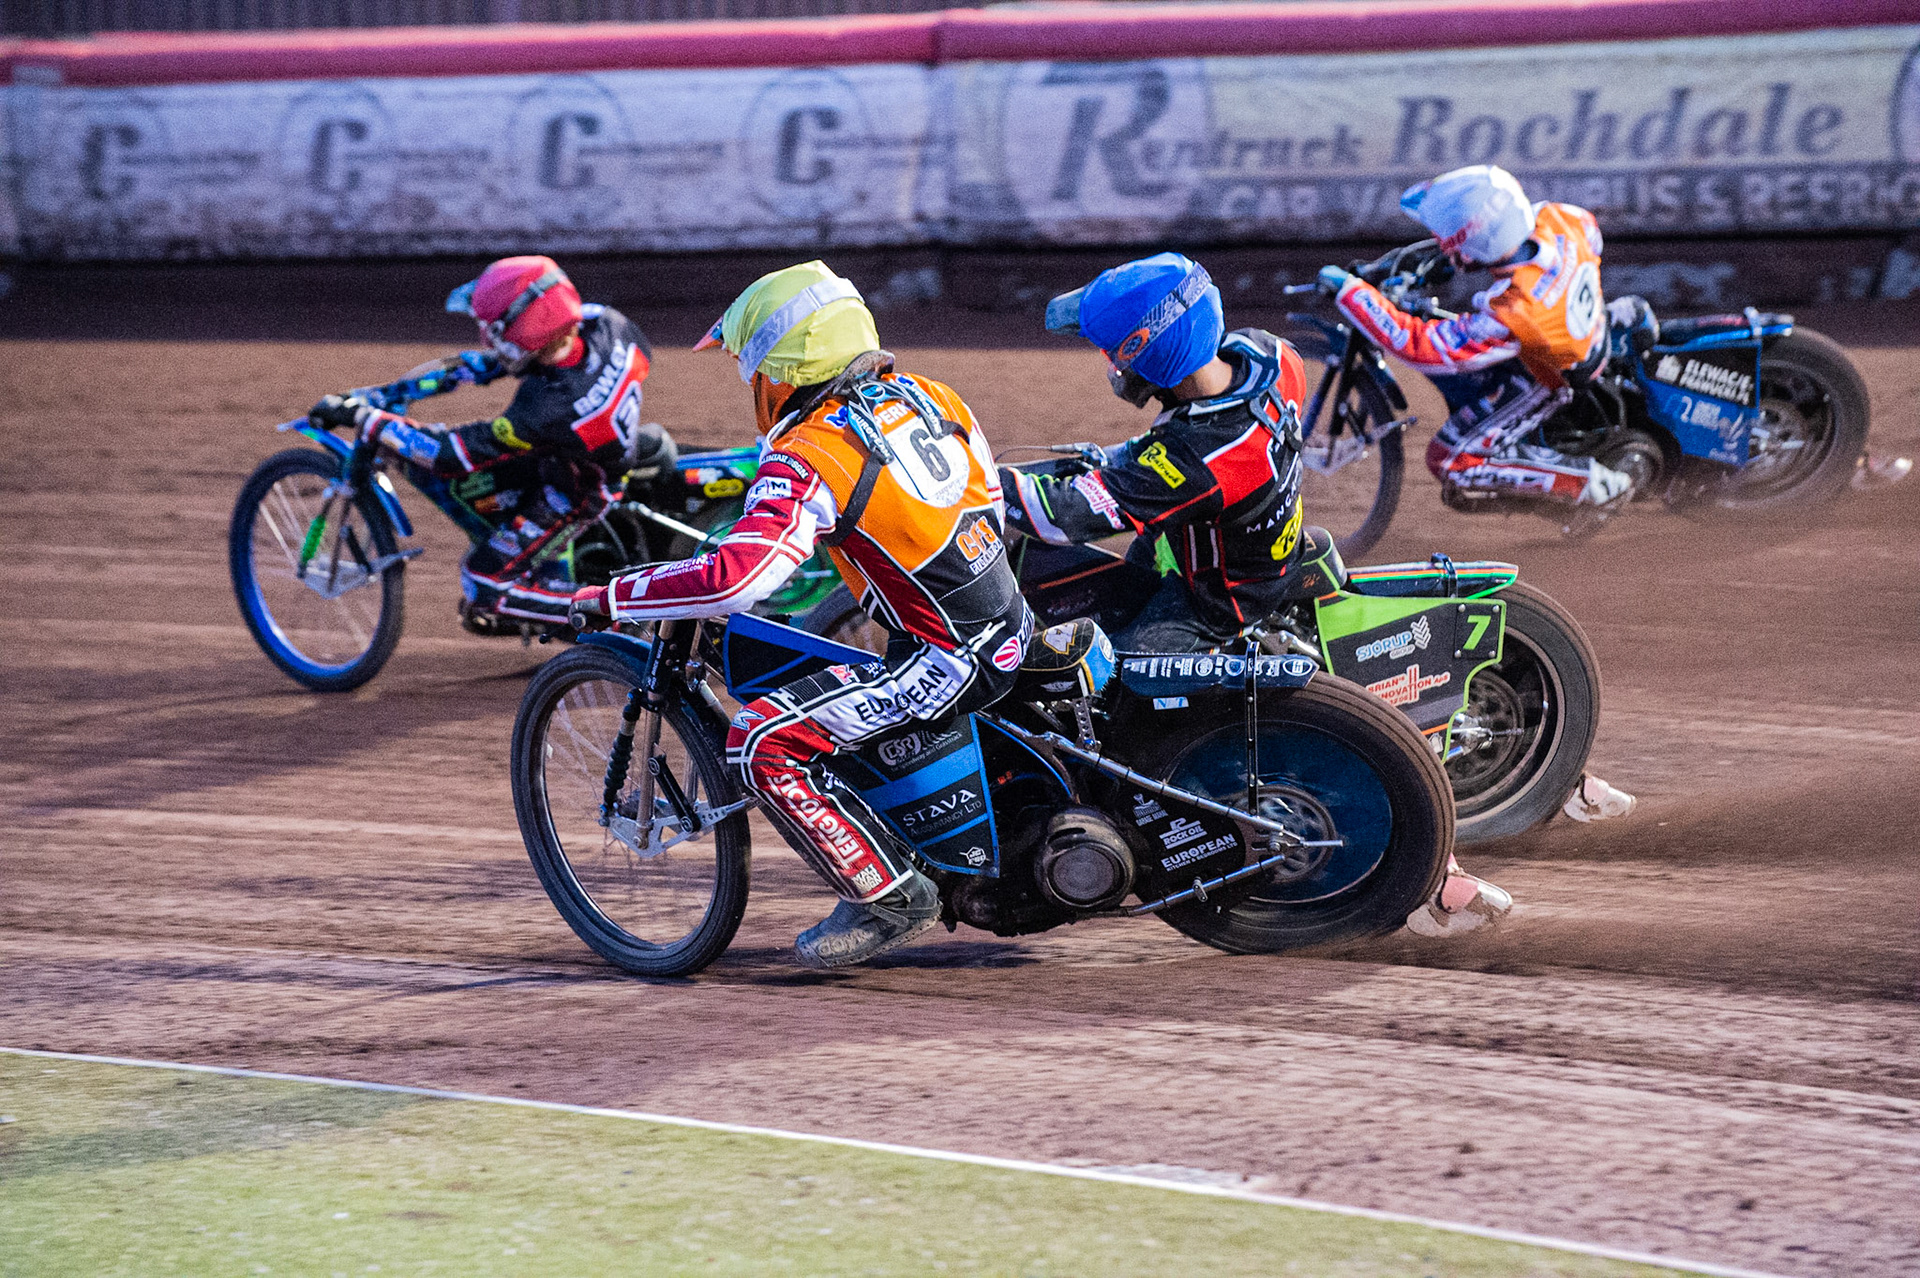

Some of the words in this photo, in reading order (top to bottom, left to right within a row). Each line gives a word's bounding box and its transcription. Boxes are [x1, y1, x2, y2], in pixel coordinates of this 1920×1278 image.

[776, 107, 839, 185] C
[1391, 81, 1844, 166] Rochdale
[539, 112, 600, 191] C
[909, 428, 951, 482] 6
[956, 516, 1000, 562] CFS
[1463, 614, 1492, 650] 7
[902, 789, 977, 827] STAVA
[1160, 833, 1237, 868] EUROPEAN
[1163, 832, 1189, 846] ROCK
[1188, 825, 1205, 836] OIL
